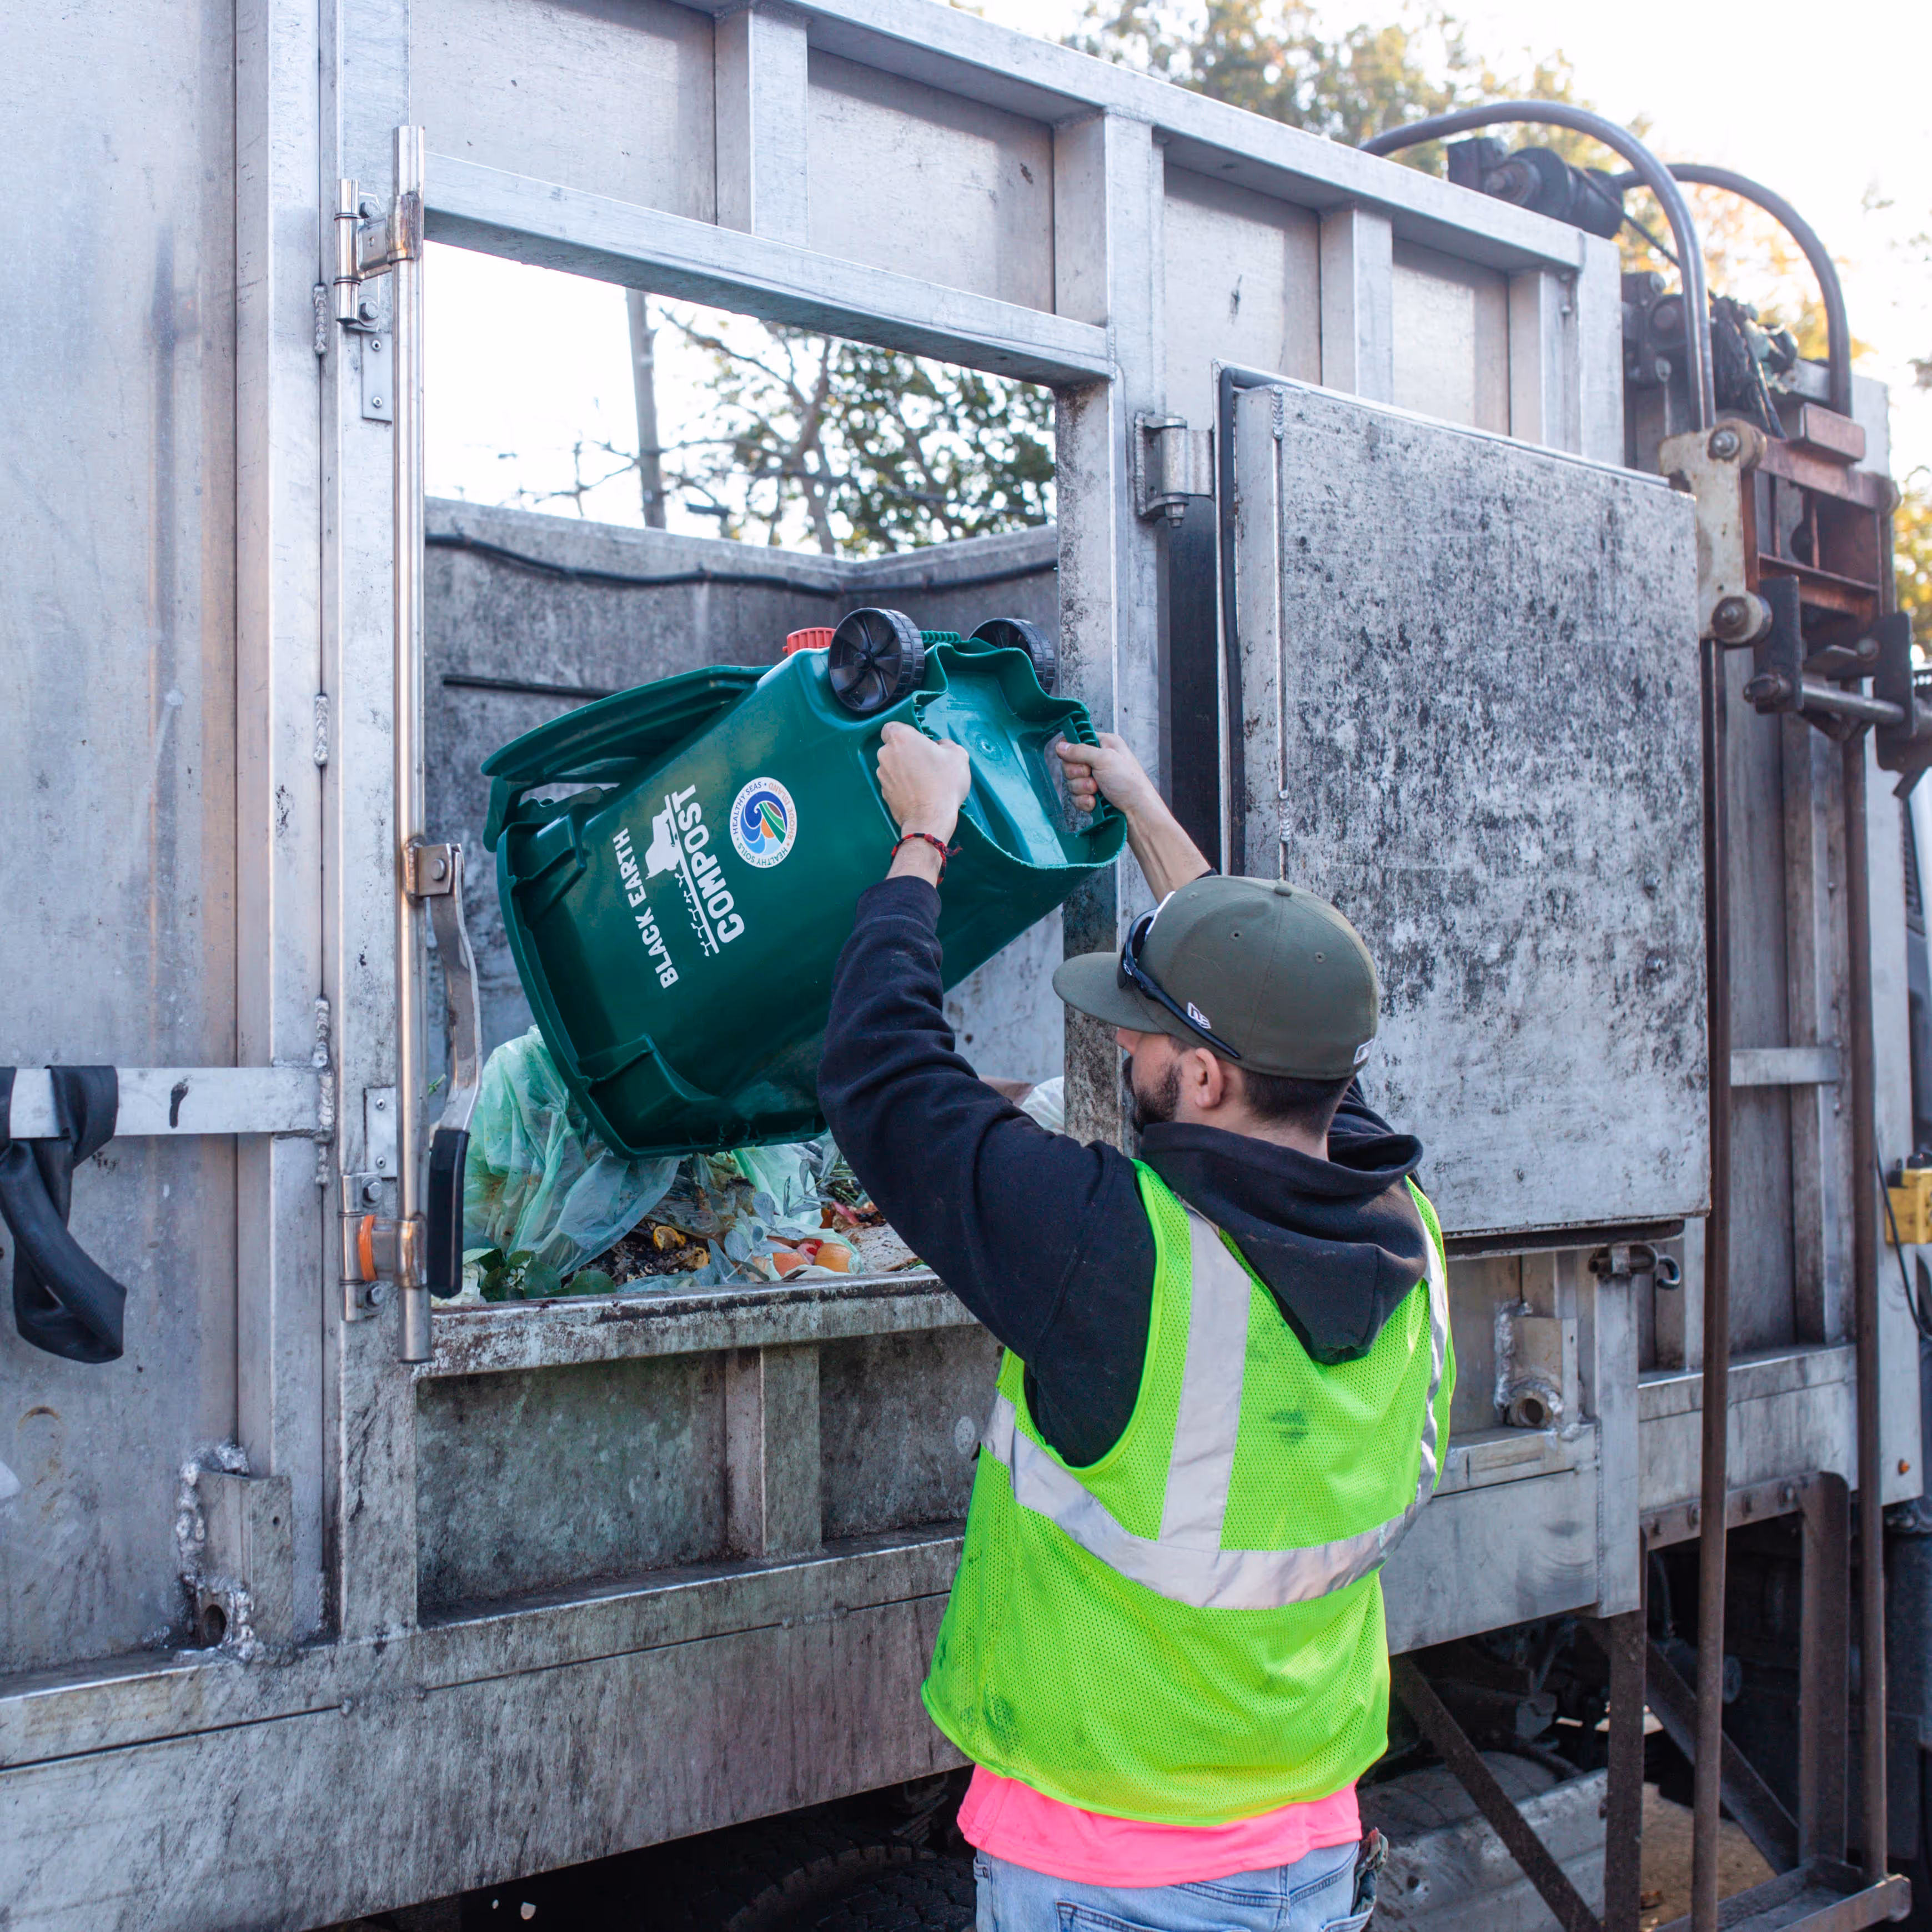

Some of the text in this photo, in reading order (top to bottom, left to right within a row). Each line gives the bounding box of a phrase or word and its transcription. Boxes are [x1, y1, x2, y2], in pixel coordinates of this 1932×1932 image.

[733, 781, 762, 835] HEALTHY SEAS
[769, 782, 795, 841] RHODE ISLAND
[671, 784, 745, 943] COMPOST
[737, 842, 788, 866] HEALTHY SOILS
[613, 828, 679, 988] BLACK EARTH
